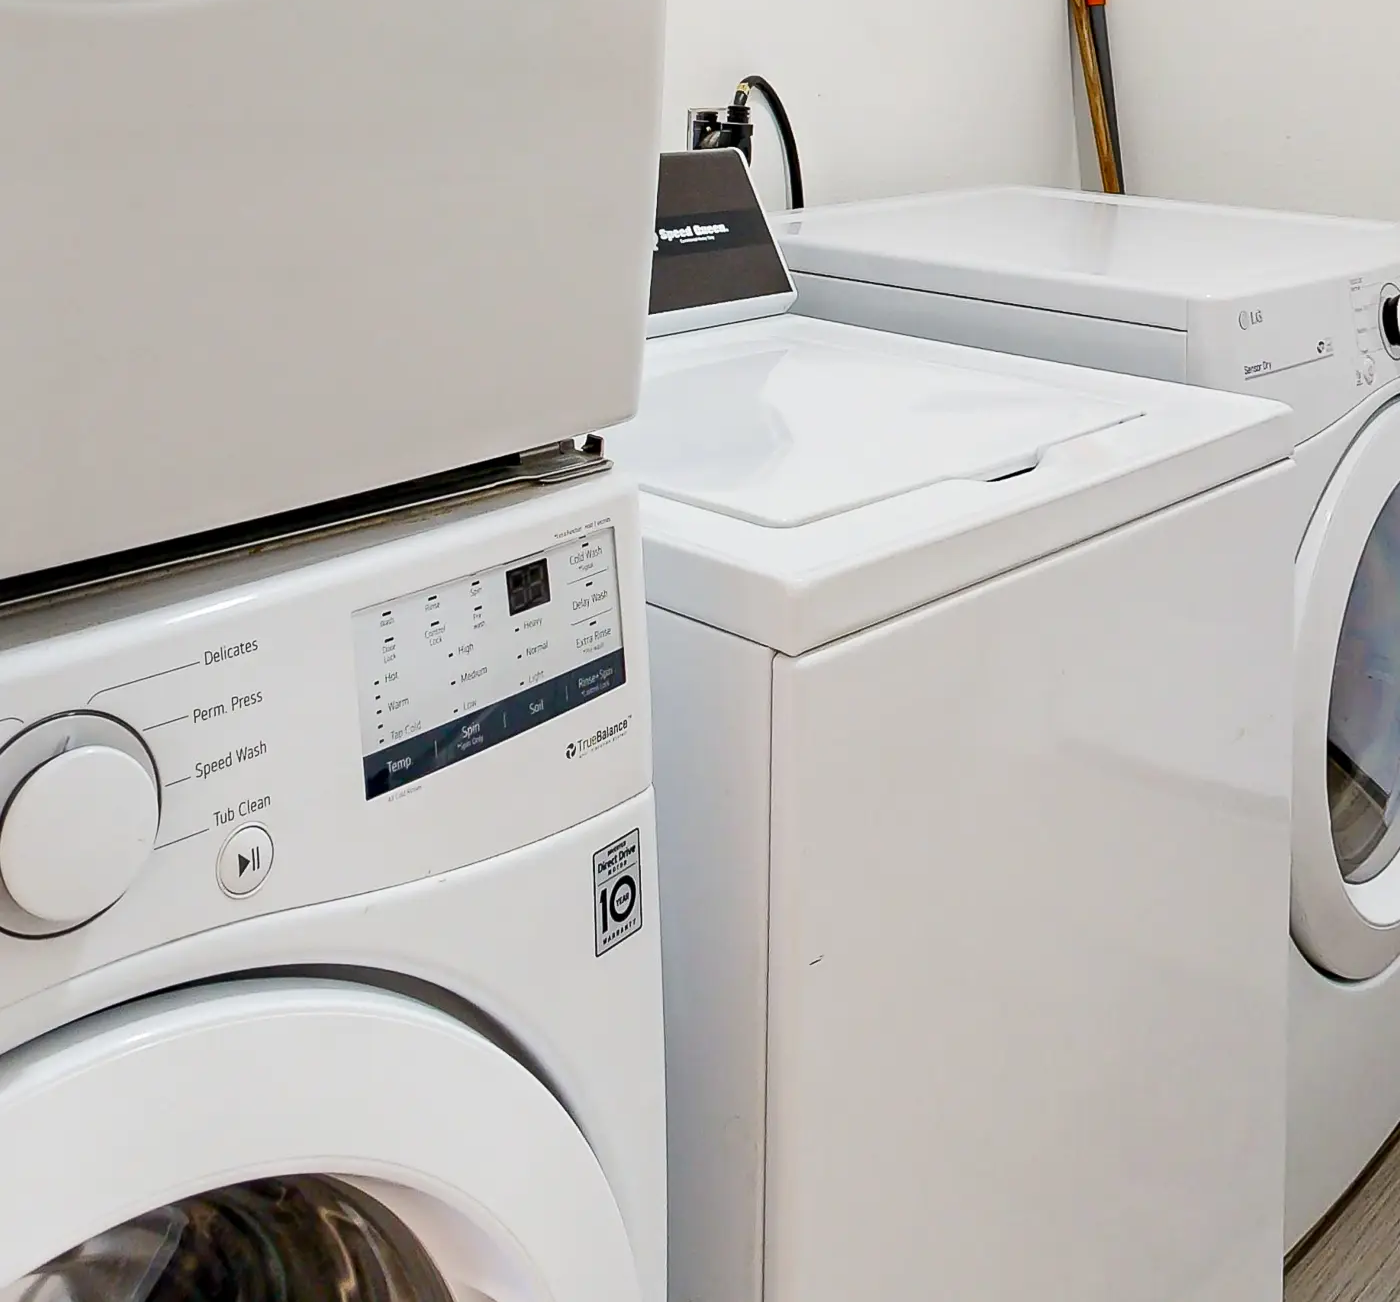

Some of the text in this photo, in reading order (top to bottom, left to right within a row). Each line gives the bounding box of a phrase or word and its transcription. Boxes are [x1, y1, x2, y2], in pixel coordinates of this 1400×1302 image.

[659, 225, 693, 241] Speed
[1250, 309, 1263, 325] LG
[569, 546, 603, 566] Cold Wash
[572, 590, 608, 611] Delay Wash
[576, 636, 593, 649] Extra
[594, 628, 612, 641] Rinse
[204, 639, 259, 666] Delicates
[458, 643, 474, 655] High
[526, 640, 549, 657] Normal
[384, 671, 399, 683] Hot
[460, 666, 488, 683] Medium
[528, 670, 544, 684] Light
[193, 690, 263, 724] Perm. Press
[387, 698, 410, 712] Warm
[463, 700, 477, 711] Low
[529, 699, 544, 715] Soil
[461, 722, 480, 739] Spin
[577, 719, 629, 752] TrueBalance
[195, 740, 268, 780] Speed Wash
[213, 795, 272, 827] Tub Clean
[597, 844, 636, 874] Direct Drive
[600, 874, 637, 934] 10
[616, 892, 630, 906] YEAR
[602, 917, 637, 946] WARRANTY
